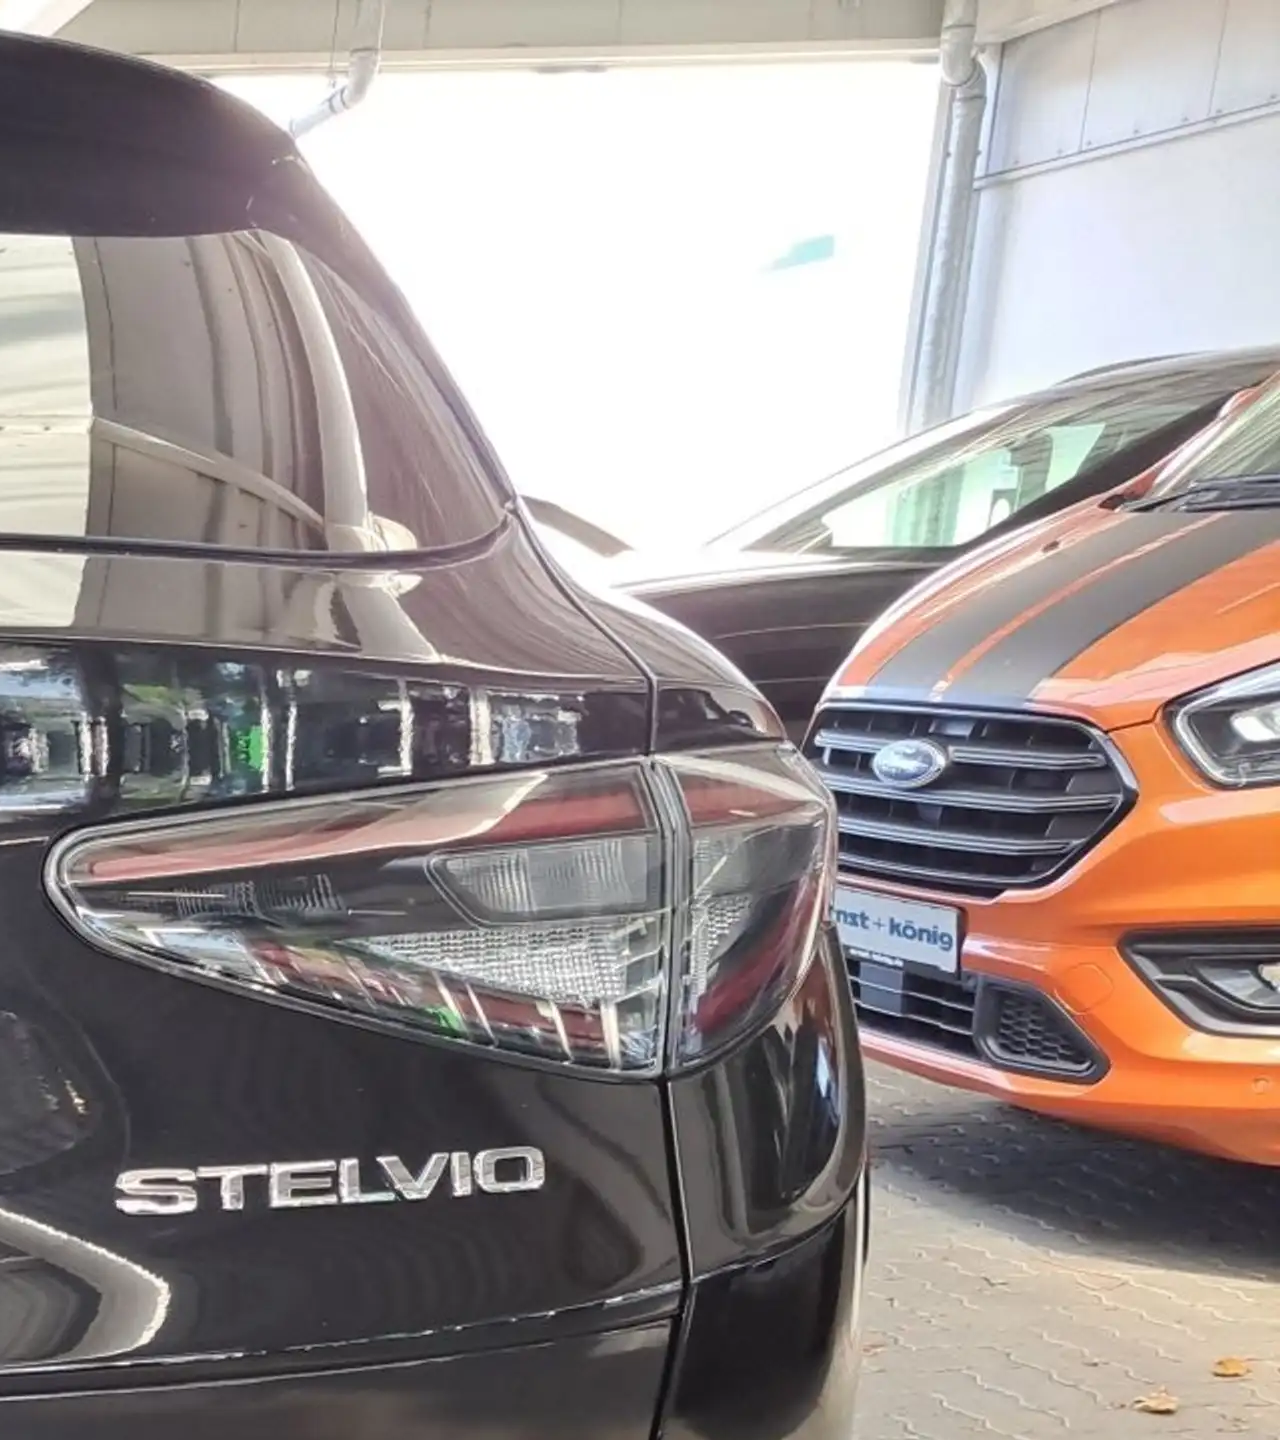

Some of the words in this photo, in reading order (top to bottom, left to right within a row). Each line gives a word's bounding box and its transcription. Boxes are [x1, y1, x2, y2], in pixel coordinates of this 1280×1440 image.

[836, 909, 870, 929] nst
[888, 916, 953, 952] könig
[115, 1145, 546, 1216] STELVIO
